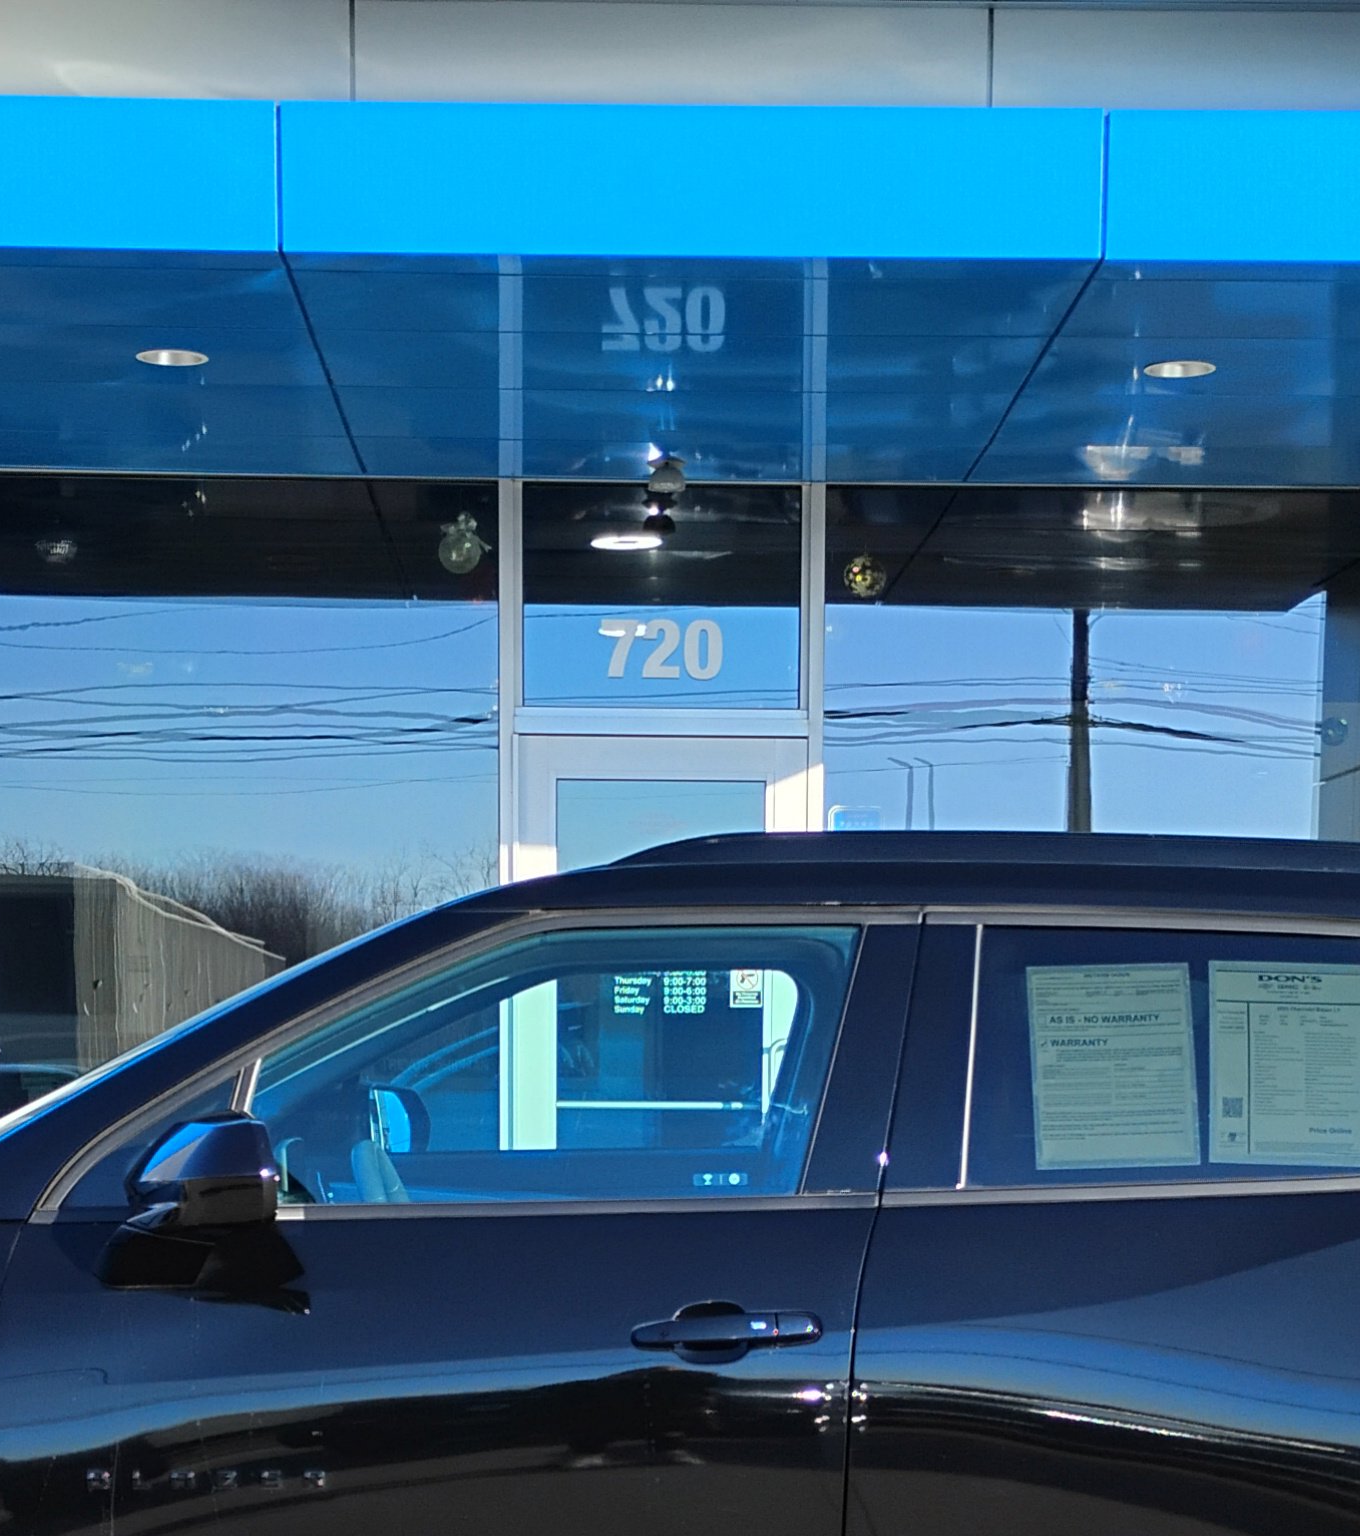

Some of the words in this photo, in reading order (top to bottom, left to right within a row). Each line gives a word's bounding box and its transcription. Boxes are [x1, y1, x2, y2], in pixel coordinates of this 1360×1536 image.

[600, 618, 724, 681] 720
[614, 976, 652, 987] Thursday
[663, 977, 707, 986] 9:00-7:00
[1258, 974, 1322, 983] DON'S
[614, 986, 640, 996] Friday
[614, 995, 650, 1006] Saturday
[614, 1005, 645, 1015] Sunday
[663, 1005, 705, 1014] CLOSED
[1049, 1015, 1063, 1024] AS
[1065, 1015, 1075, 1024] IS
[1083, 1015, 1099, 1024] NO
[1101, 1013, 1160, 1024] WARRANTY
[1050, 1038, 1108, 1047] WARRANTY
